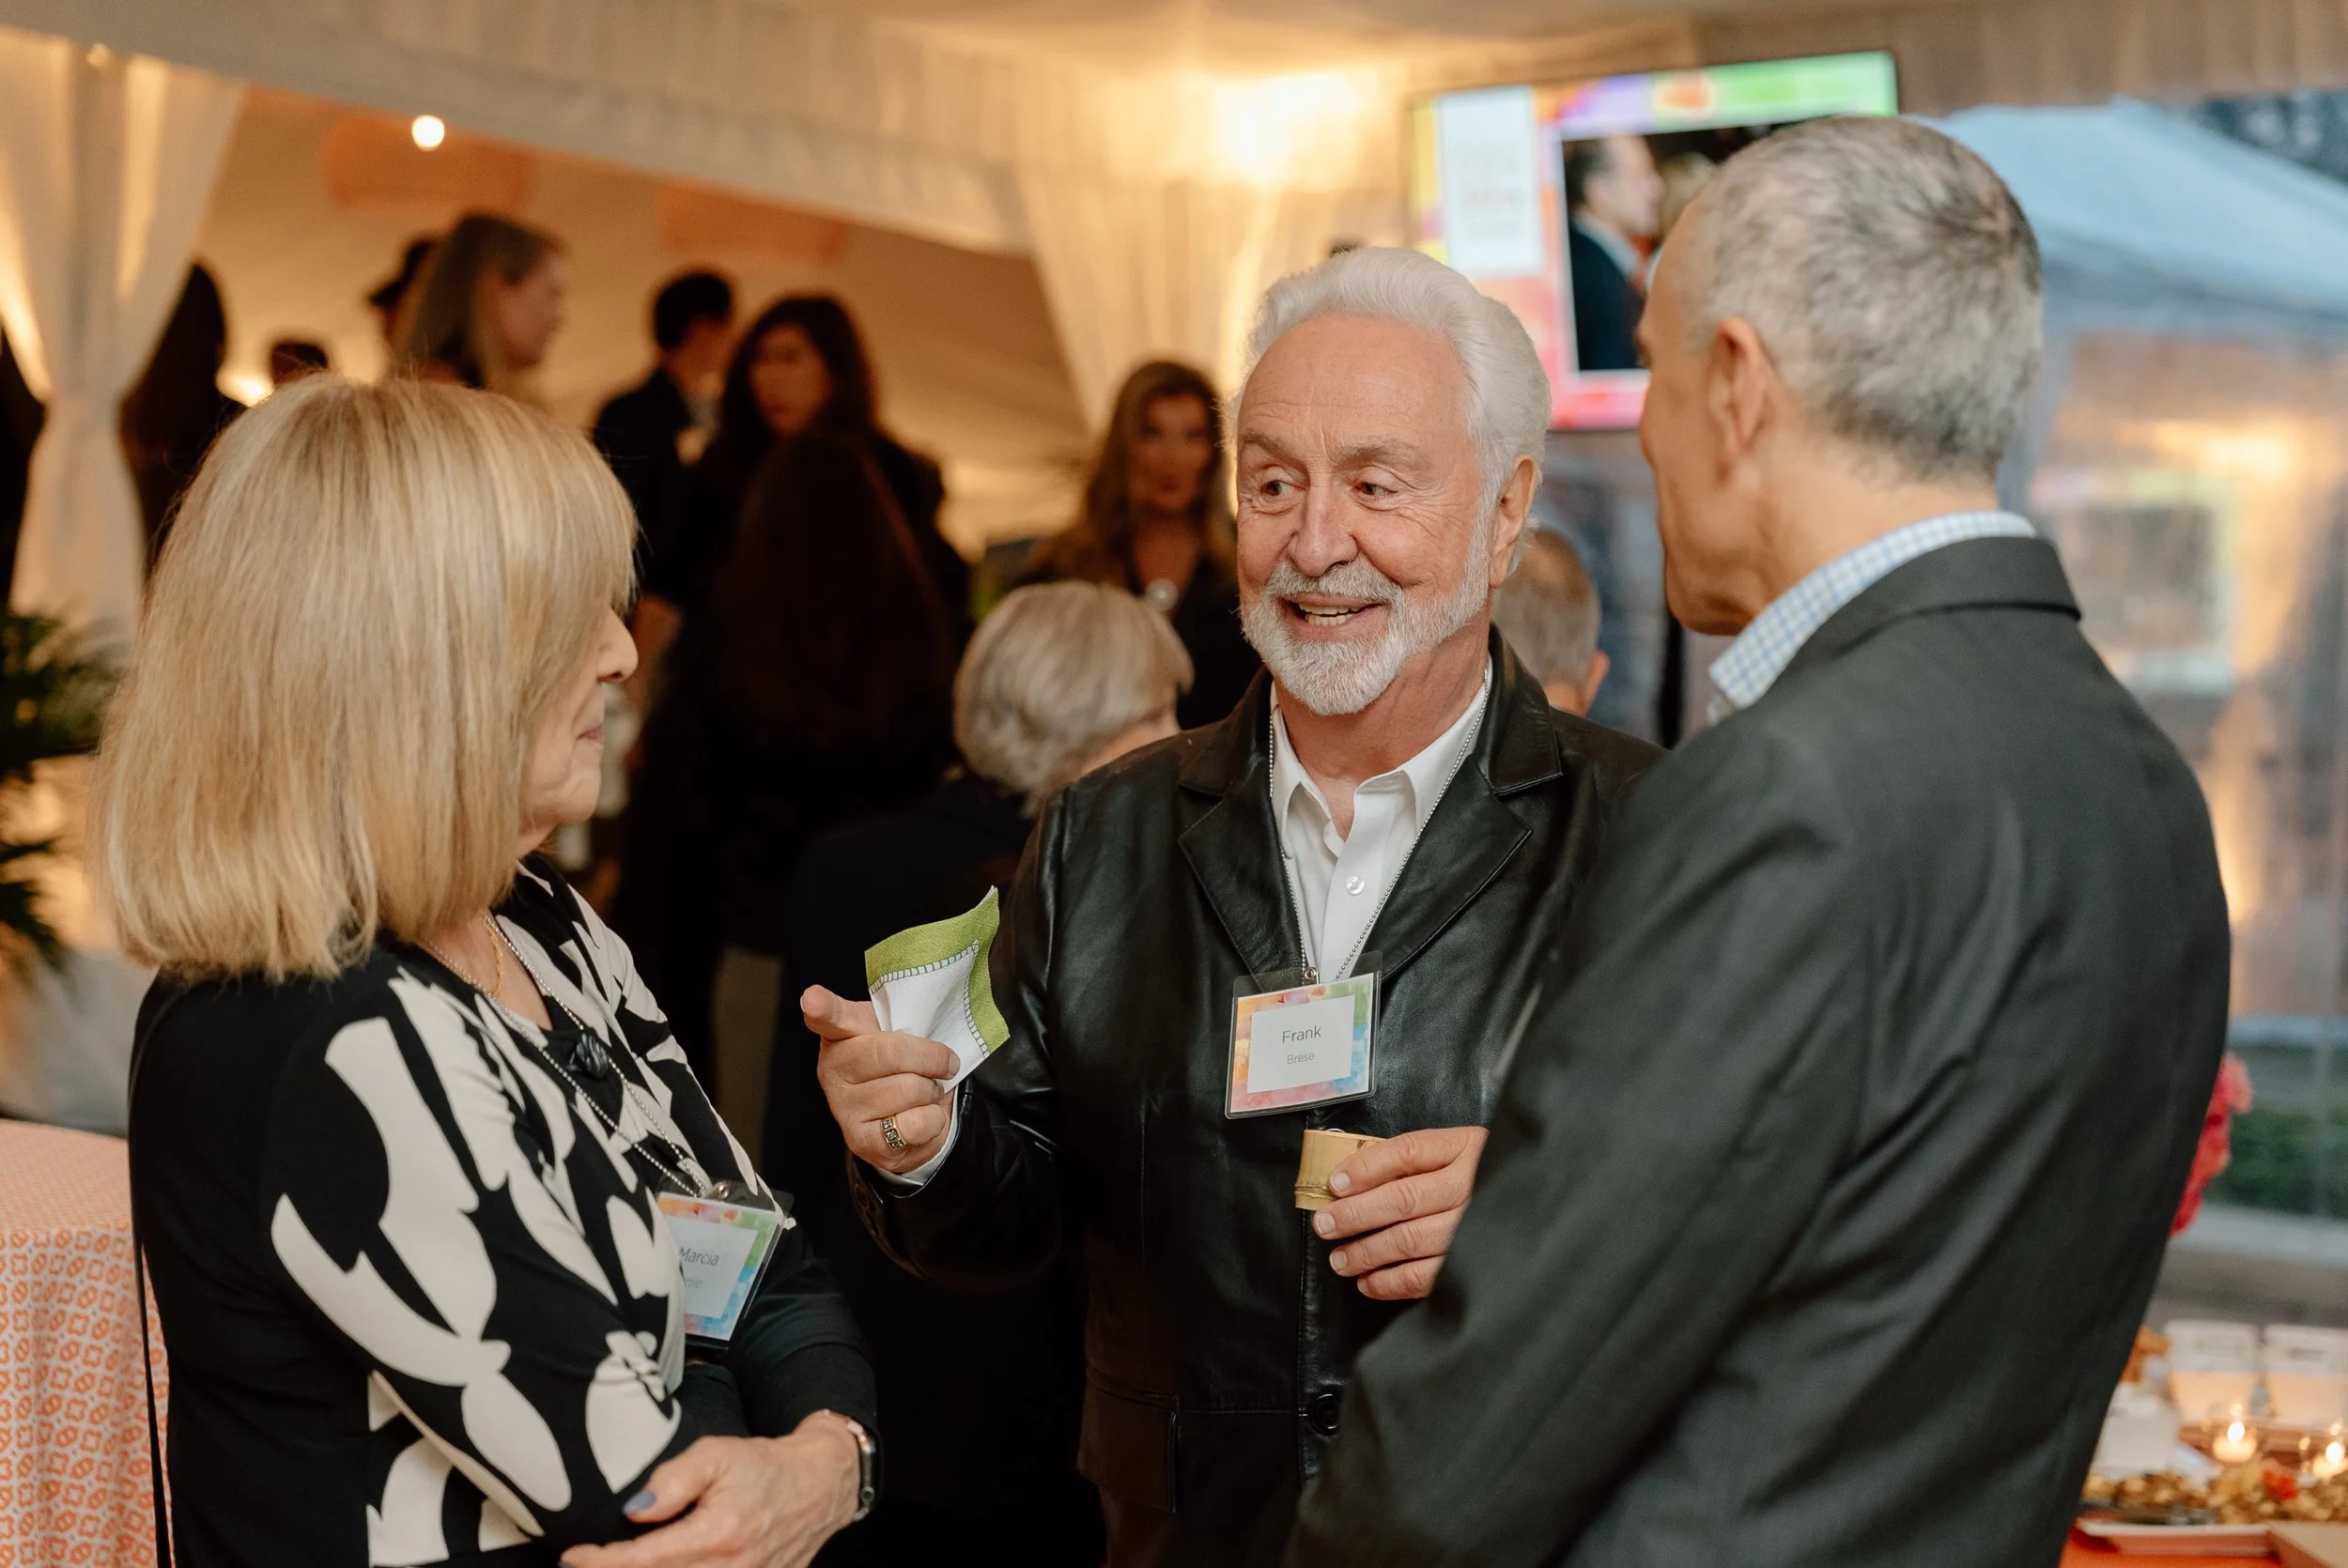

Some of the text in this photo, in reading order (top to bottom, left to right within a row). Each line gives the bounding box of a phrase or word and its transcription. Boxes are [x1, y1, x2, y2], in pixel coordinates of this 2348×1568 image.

[1282, 1024, 1321, 1043] Frank
[1287, 1053, 1315, 1065] Brese
[679, 1247, 719, 1266] Marcia
